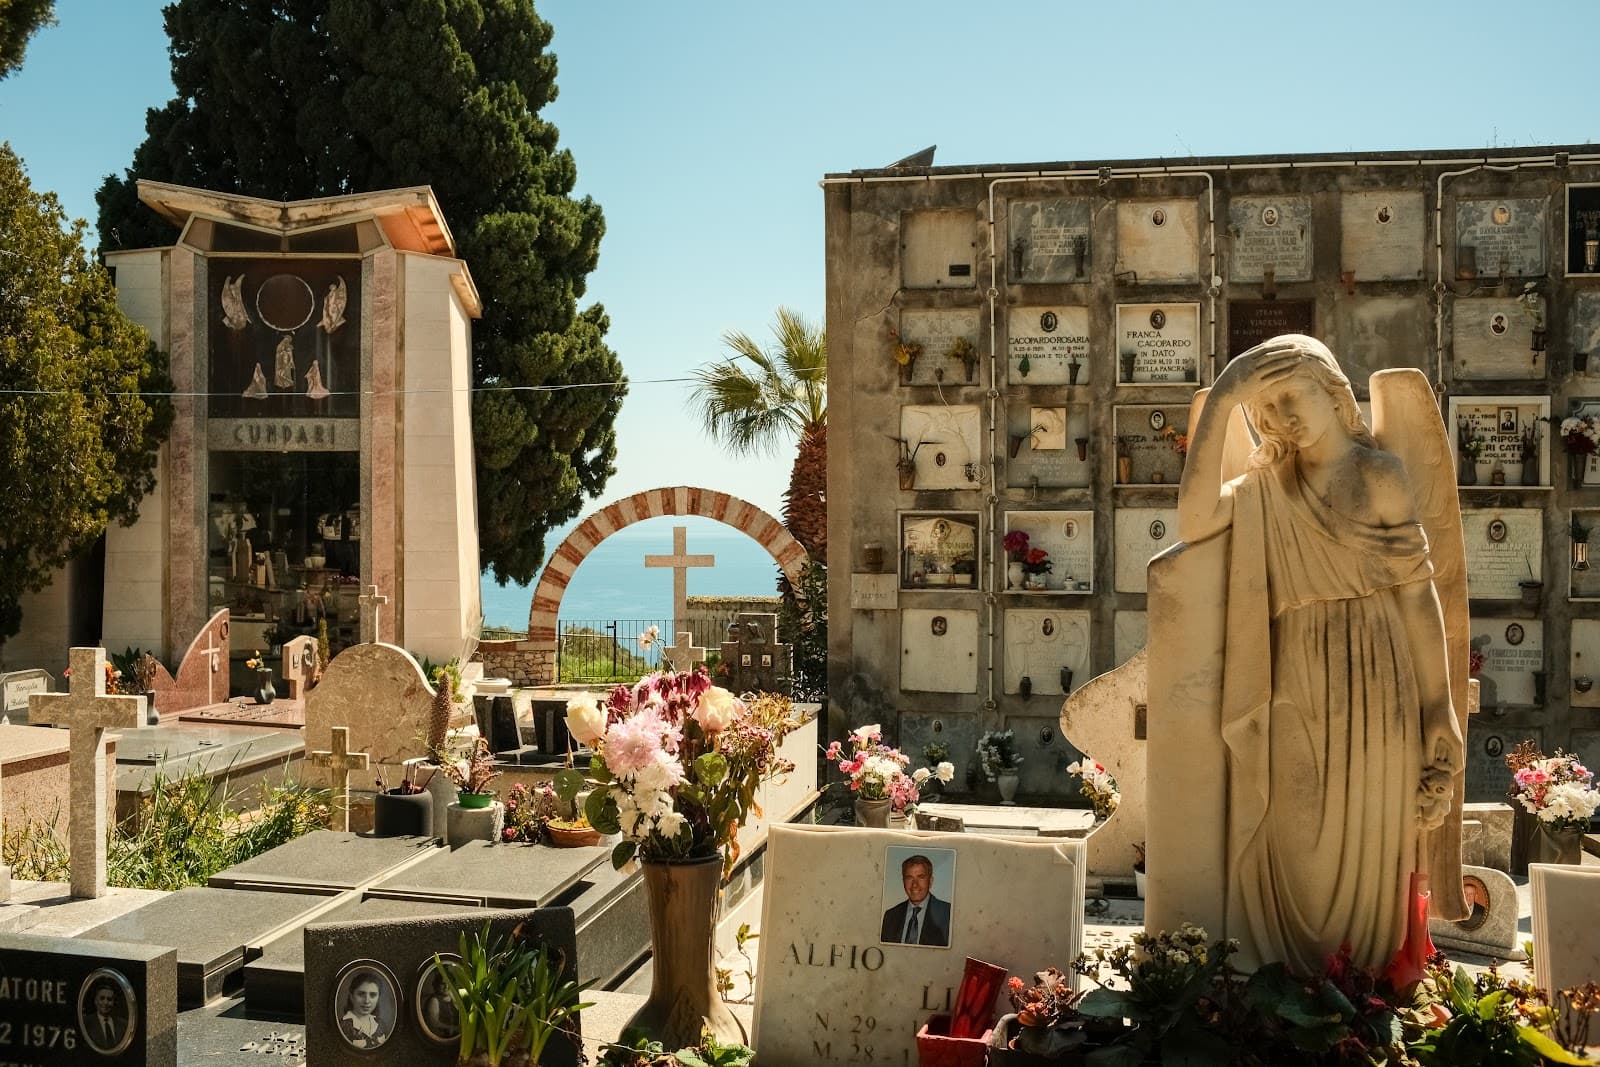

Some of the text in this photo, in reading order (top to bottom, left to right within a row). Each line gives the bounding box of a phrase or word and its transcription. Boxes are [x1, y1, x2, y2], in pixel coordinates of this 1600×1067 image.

[1008, 336, 1090, 345] CACOPARDO ROSARIA
[1127, 331, 1162, 339] FRANCA
[1137, 340, 1192, 348] CACOPARDO
[1152, 349, 1176, 357] DATO
[232, 423, 336, 445] CUNDARI
[1490, 435, 1521, 443] RIPOS
[1499, 444, 1524, 452] CATE
[780, 941, 885, 972] ALFIO
[0, 976, 67, 1004] ATORE
[814, 1011, 838, 1032] N.
[851, 1014, 878, 1034] 29
[23, 1023, 77, 1050] 1976
[812, 1040, 839, 1061] M.
[849, 1044, 875, 1063] 28
